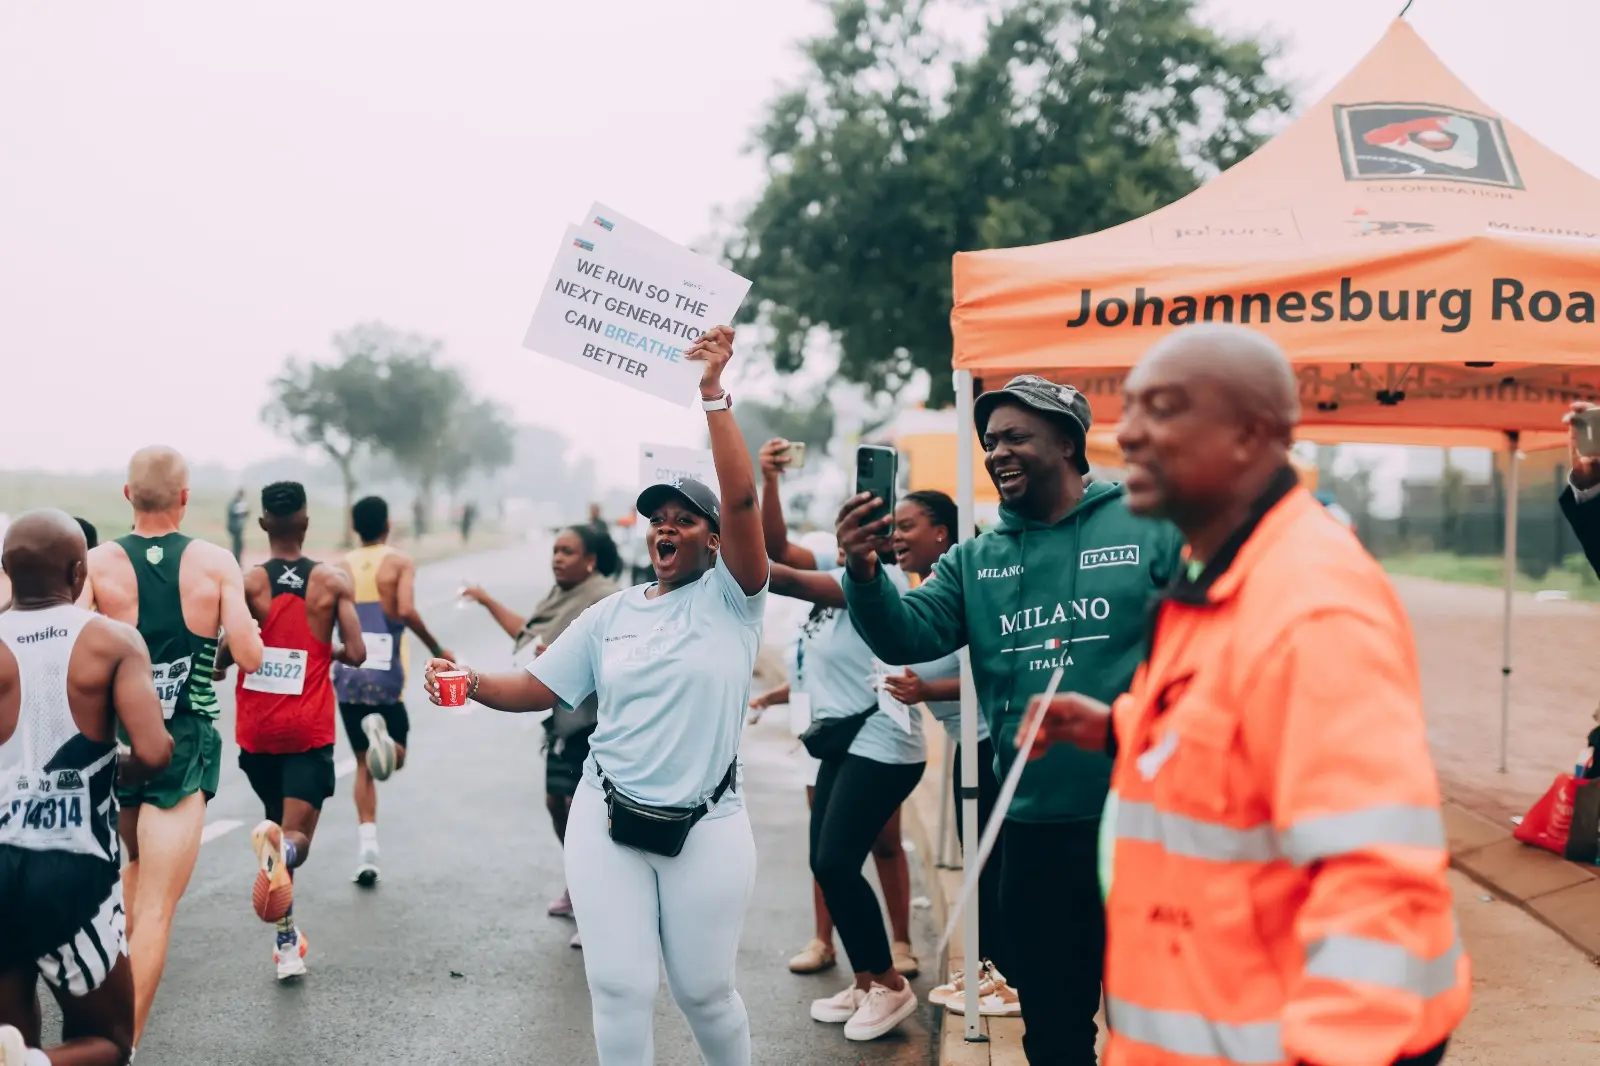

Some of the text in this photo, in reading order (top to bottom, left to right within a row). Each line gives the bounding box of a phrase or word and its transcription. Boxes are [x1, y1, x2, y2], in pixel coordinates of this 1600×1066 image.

[554, 278, 604, 305] NEXT
[577, 257, 605, 280] WE
[605, 269, 644, 295] RUN
[644, 284, 670, 304] SO
[675, 293, 709, 318] THE
[1066, 277, 1596, 333] Johannesburg Roa
[564, 309, 684, 363] CAN BREATHE
[581, 342, 649, 379] BETTER
[1083, 549, 1136, 565] ITALIA
[977, 564, 1024, 580] MILANO
[999, 597, 1110, 636] MILANO
[16, 625, 68, 644] entsika
[1029, 655, 1075, 671] ITALIA
[59, 769, 80, 783] ASA
